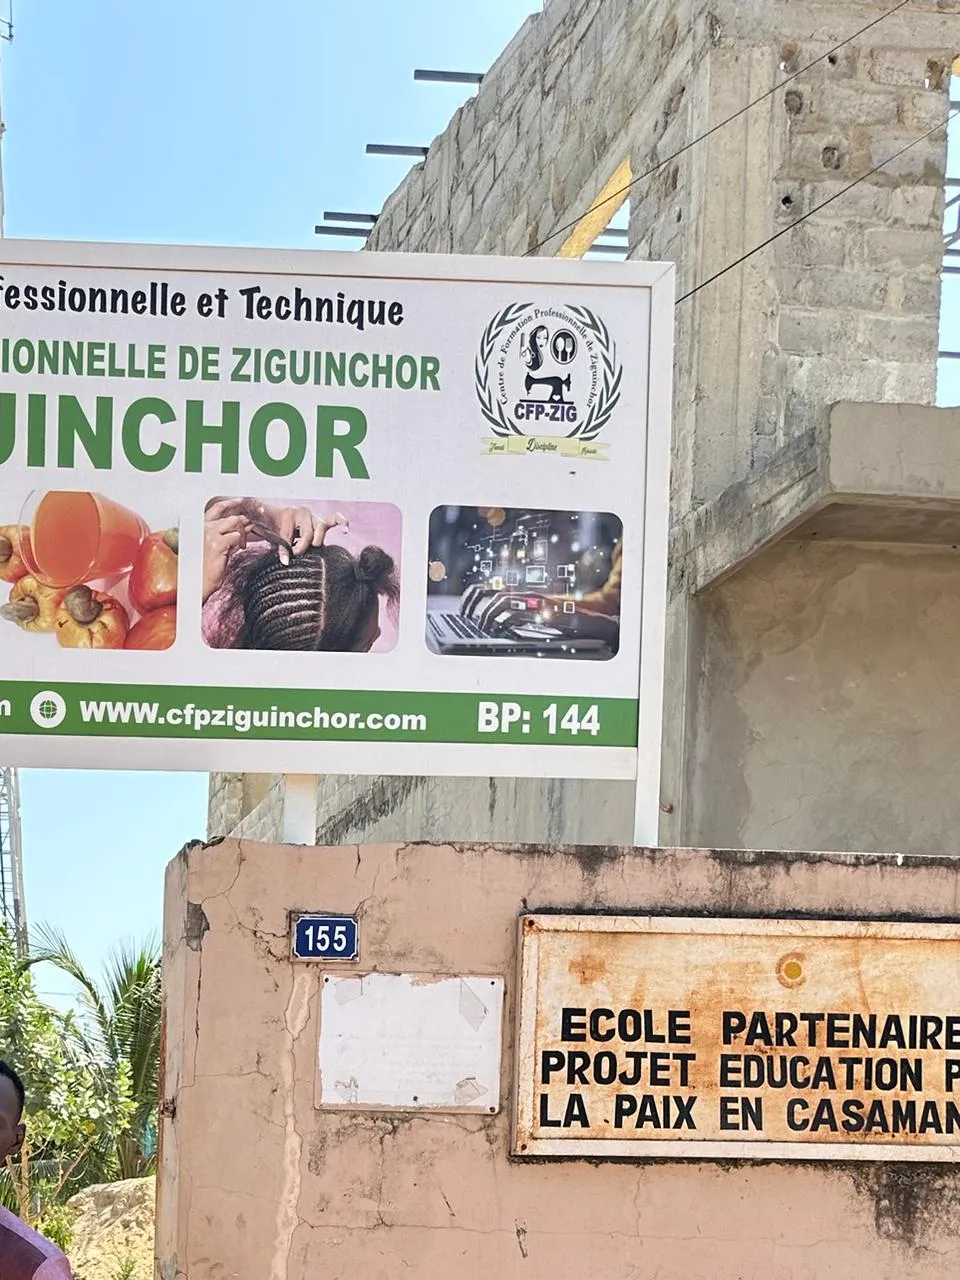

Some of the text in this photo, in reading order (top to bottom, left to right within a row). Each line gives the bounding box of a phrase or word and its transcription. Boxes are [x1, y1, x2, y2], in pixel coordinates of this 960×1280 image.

[197, 288, 229, 318] et
[239, 286, 404, 331] Technique
[178, 345, 220, 381] DE
[231, 347, 440, 391] ZIGUINCHOR
[514, 402, 577, 421] CFP-ZIG
[477, 701, 601, 736] BP: 144
[305, 925, 347, 952] 155
[561, 1007, 960, 1050] ECOLE PARTENAIRE
[541, 1050, 696, 1087] PROJET
[720, 1053, 923, 1092] EDUCATION
[540, 1093, 590, 1128] LA
[614, 1094, 697, 1130] PAIX
[720, 1096, 763, 1131] EN
